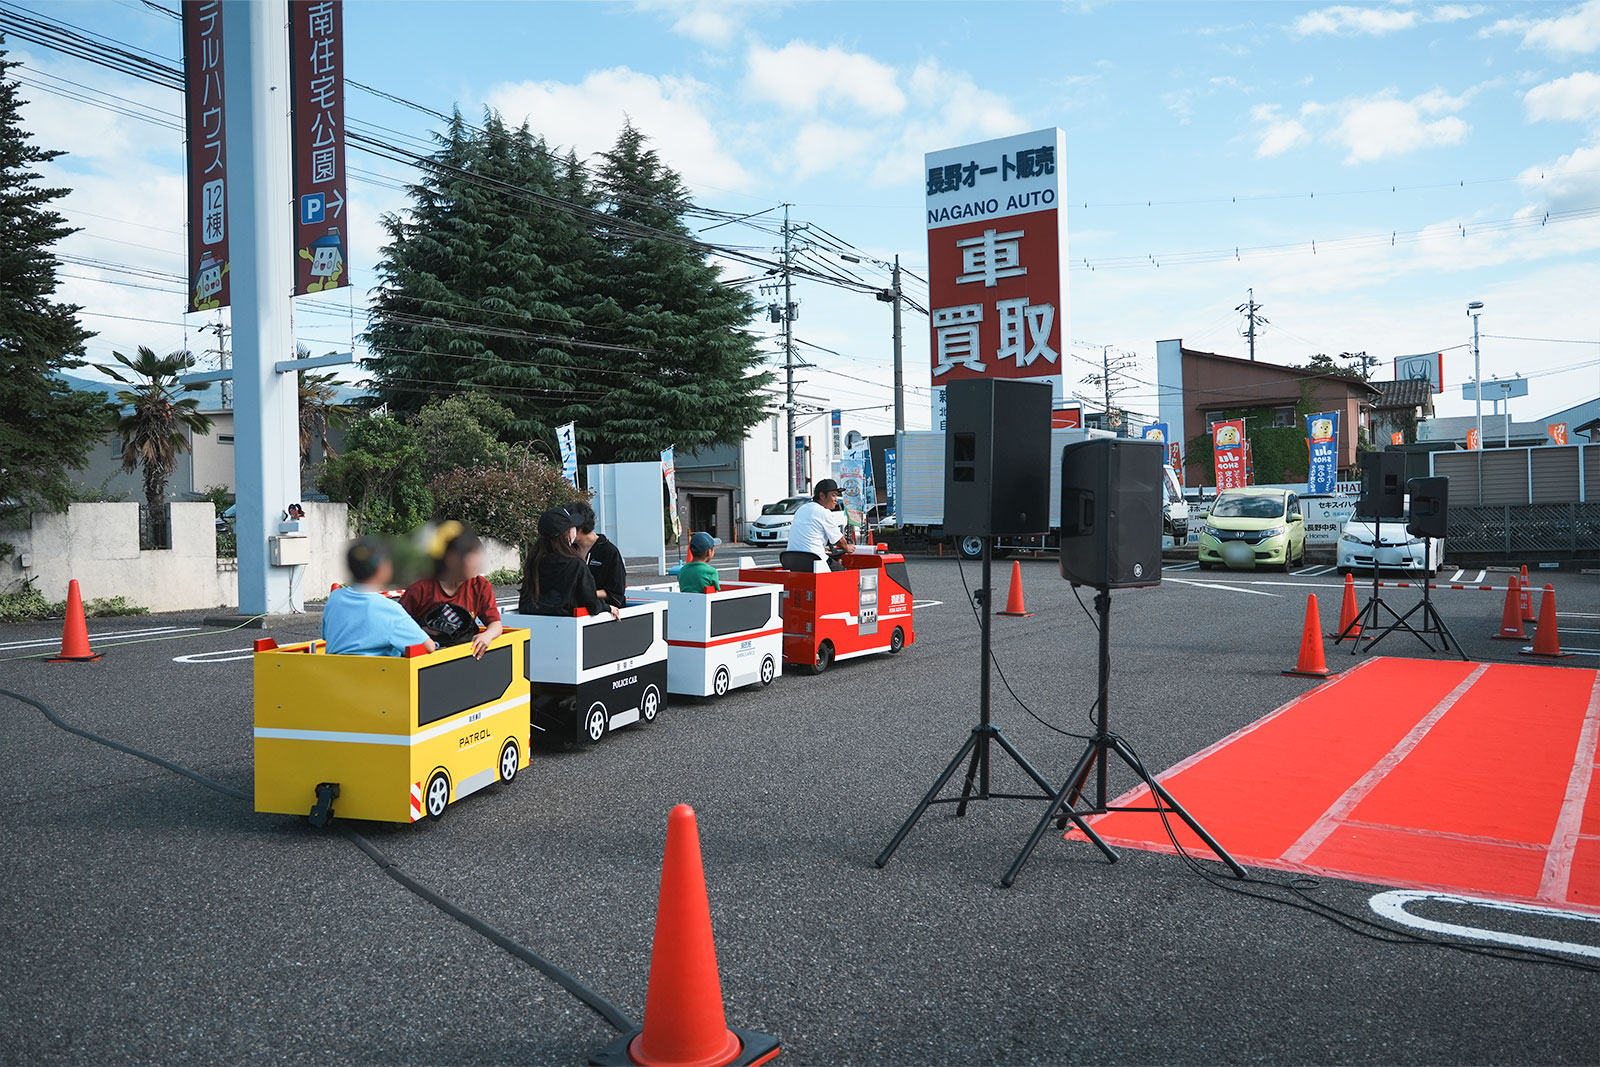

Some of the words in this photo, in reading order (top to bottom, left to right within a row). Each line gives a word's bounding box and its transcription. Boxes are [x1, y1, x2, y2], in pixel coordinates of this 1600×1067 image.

[200, 0, 223, 174] デルハウス
[308, 2, 336, 184] 南住宅公園
[927, 146, 1055, 196] 長野オート販売
[206, 187, 222, 240] 12棟
[307, 198, 321, 219] P
[928, 199, 999, 223] NAGANO
[1006, 189, 1055, 211] AUTO
[956, 228, 1028, 287] 車
[932, 297, 1059, 377] 買取
[612, 678, 629, 690] POLICE
[459, 728, 491, 748] PATROL
